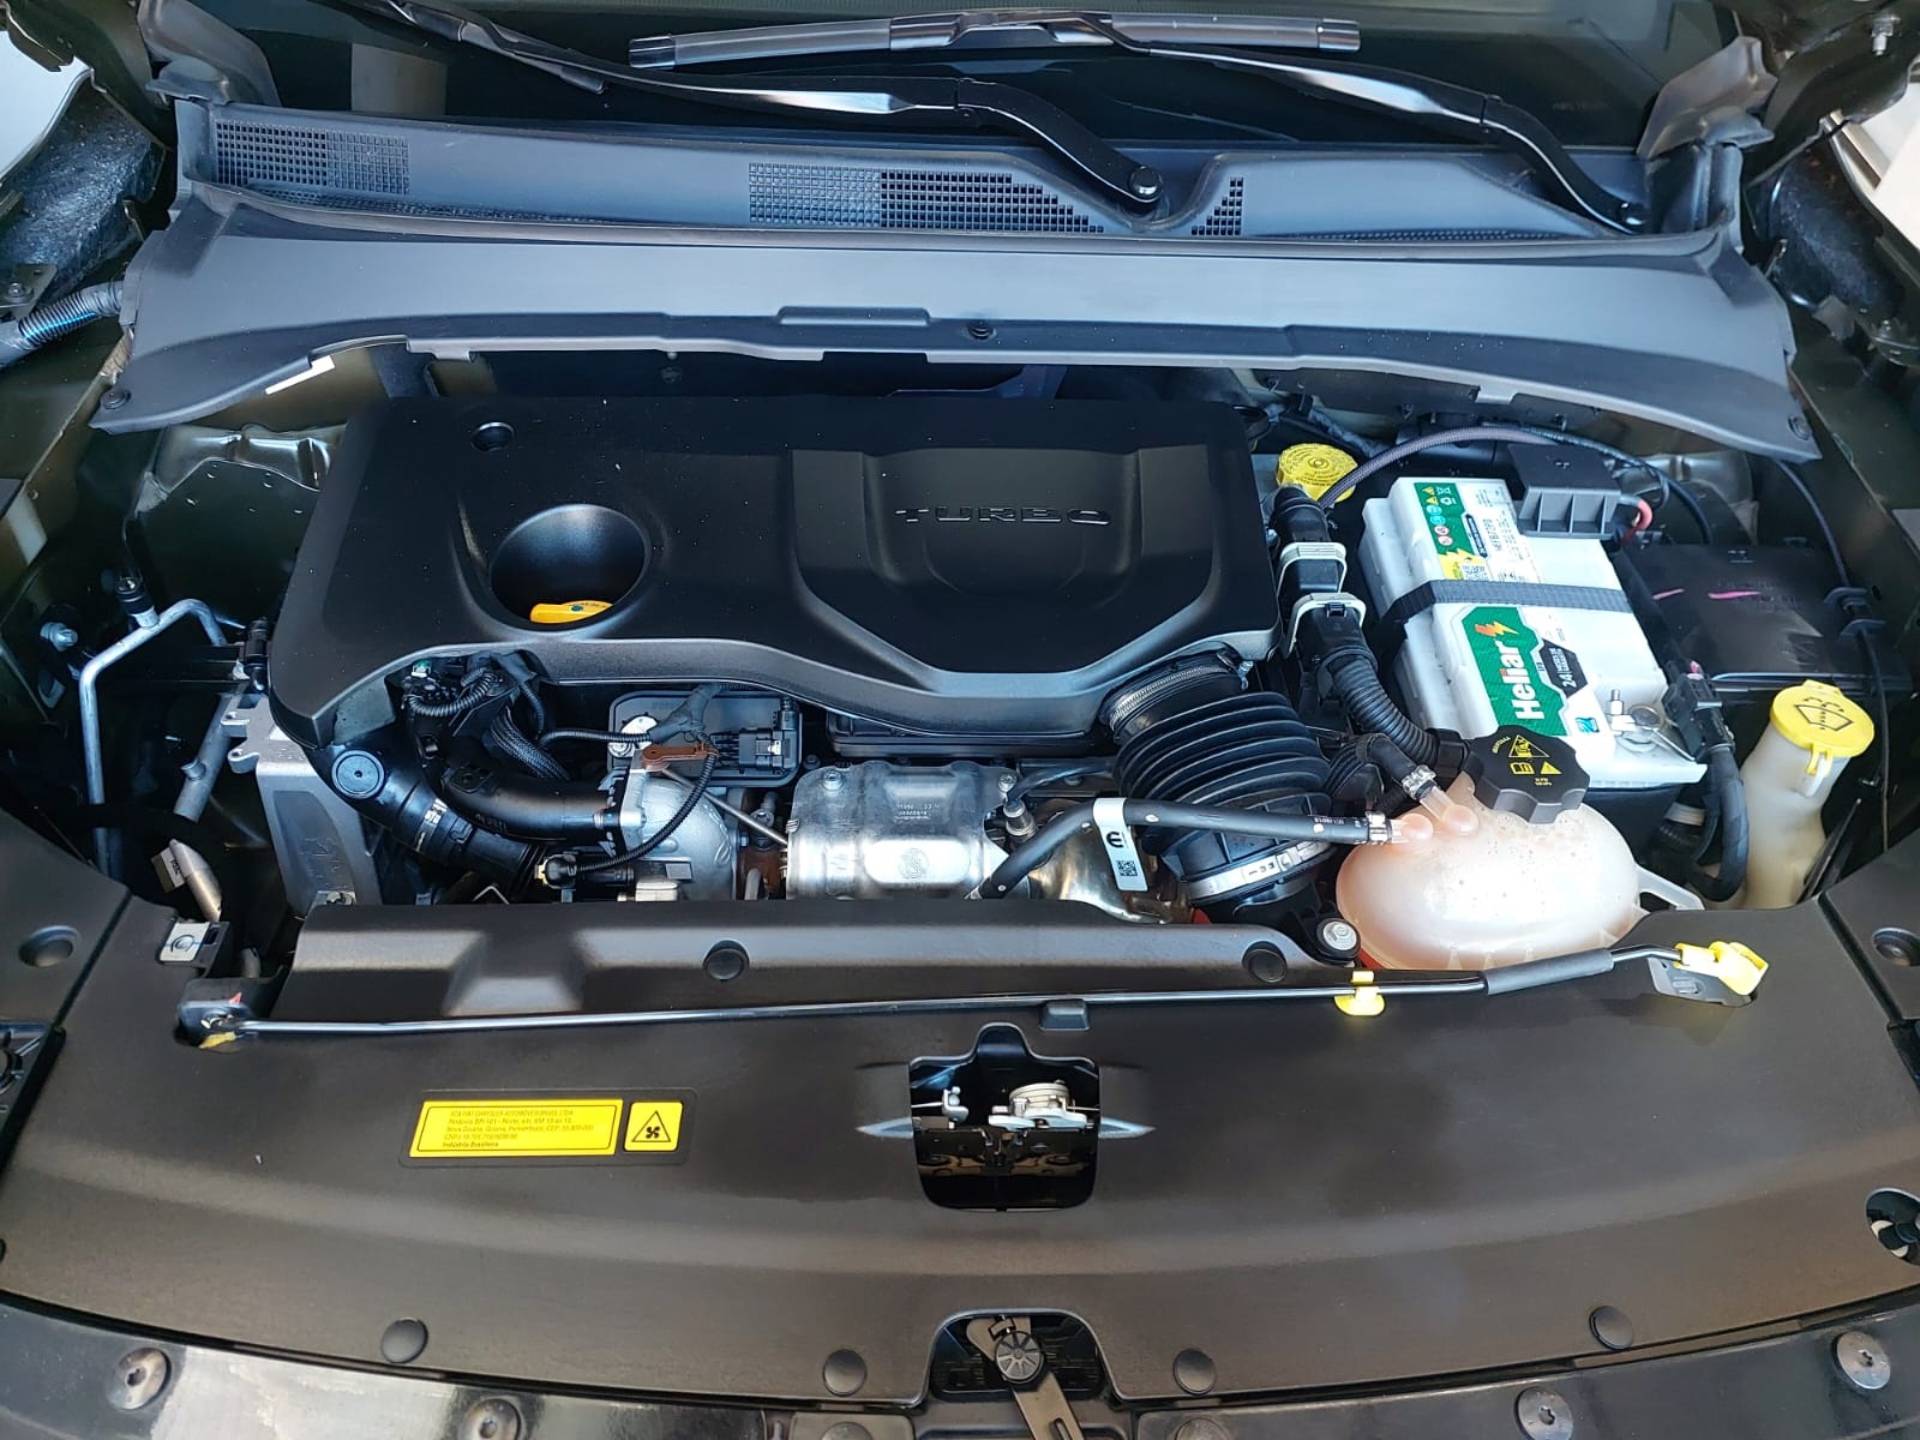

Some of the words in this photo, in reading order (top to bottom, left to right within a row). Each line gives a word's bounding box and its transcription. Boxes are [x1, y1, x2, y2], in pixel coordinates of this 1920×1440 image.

[895, 506, 1111, 525] TURBO
[1494, 640, 1545, 720] Heliar
[1558, 673, 1578, 688] 24
